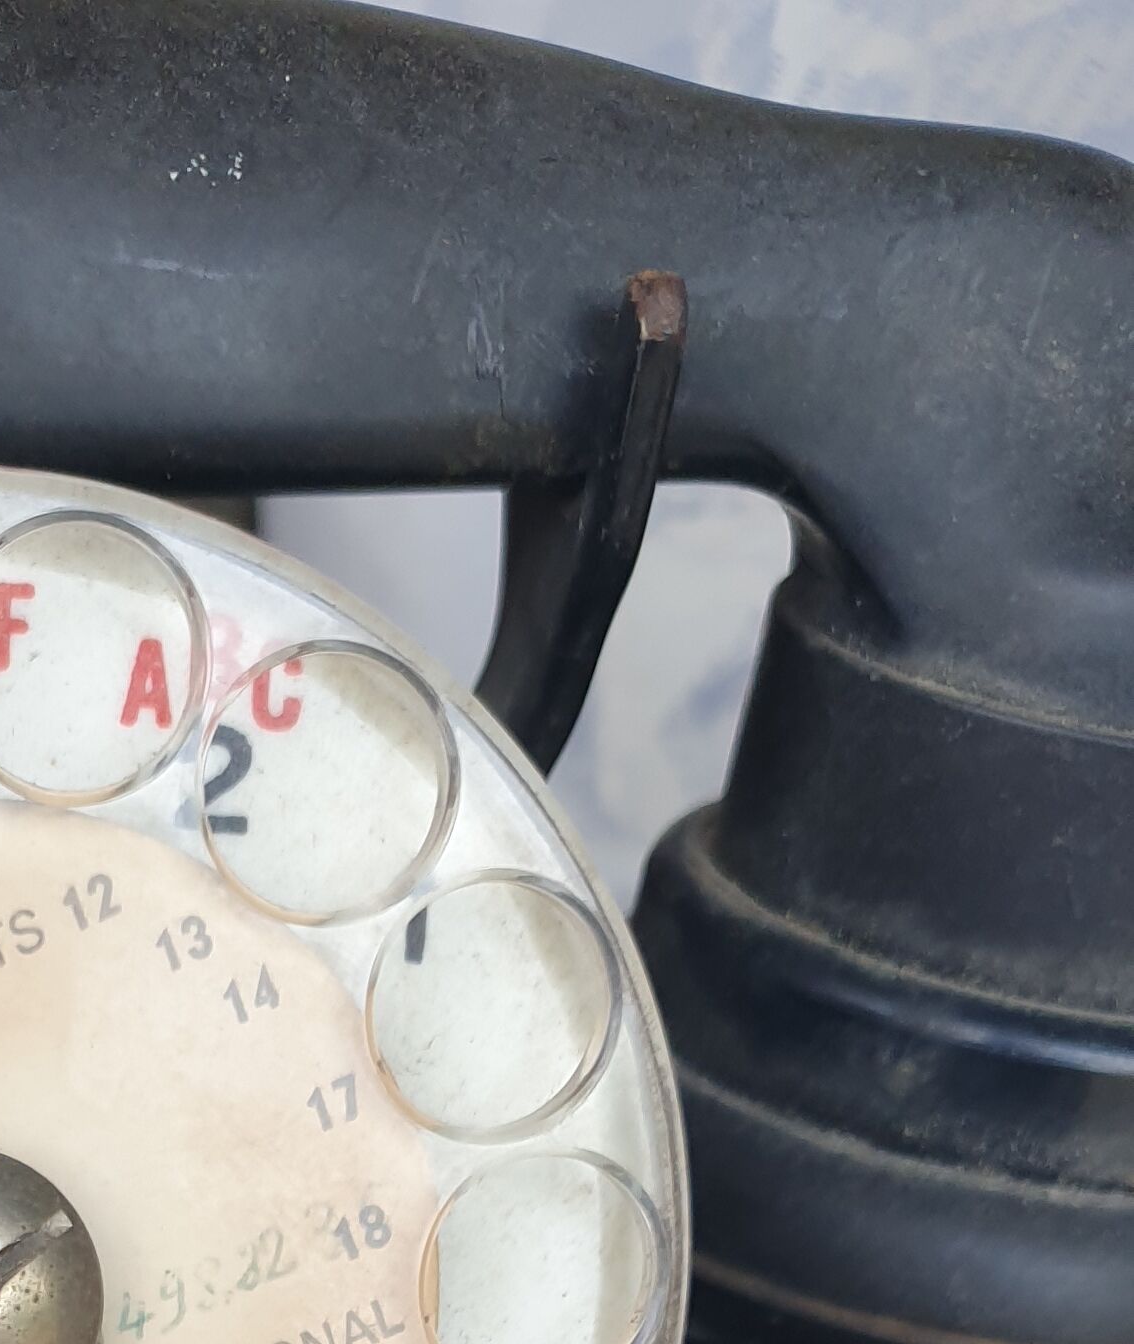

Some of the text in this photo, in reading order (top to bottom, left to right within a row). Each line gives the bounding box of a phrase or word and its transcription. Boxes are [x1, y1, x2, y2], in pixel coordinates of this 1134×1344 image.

[174, 723, 253, 835] 2
[64, 874, 122, 931] 12
[155, 915, 214, 971] 13
[223, 963, 280, 1024] 14
[306, 1074, 359, 1132] 17
[333, 1205, 392, 1261] 18
